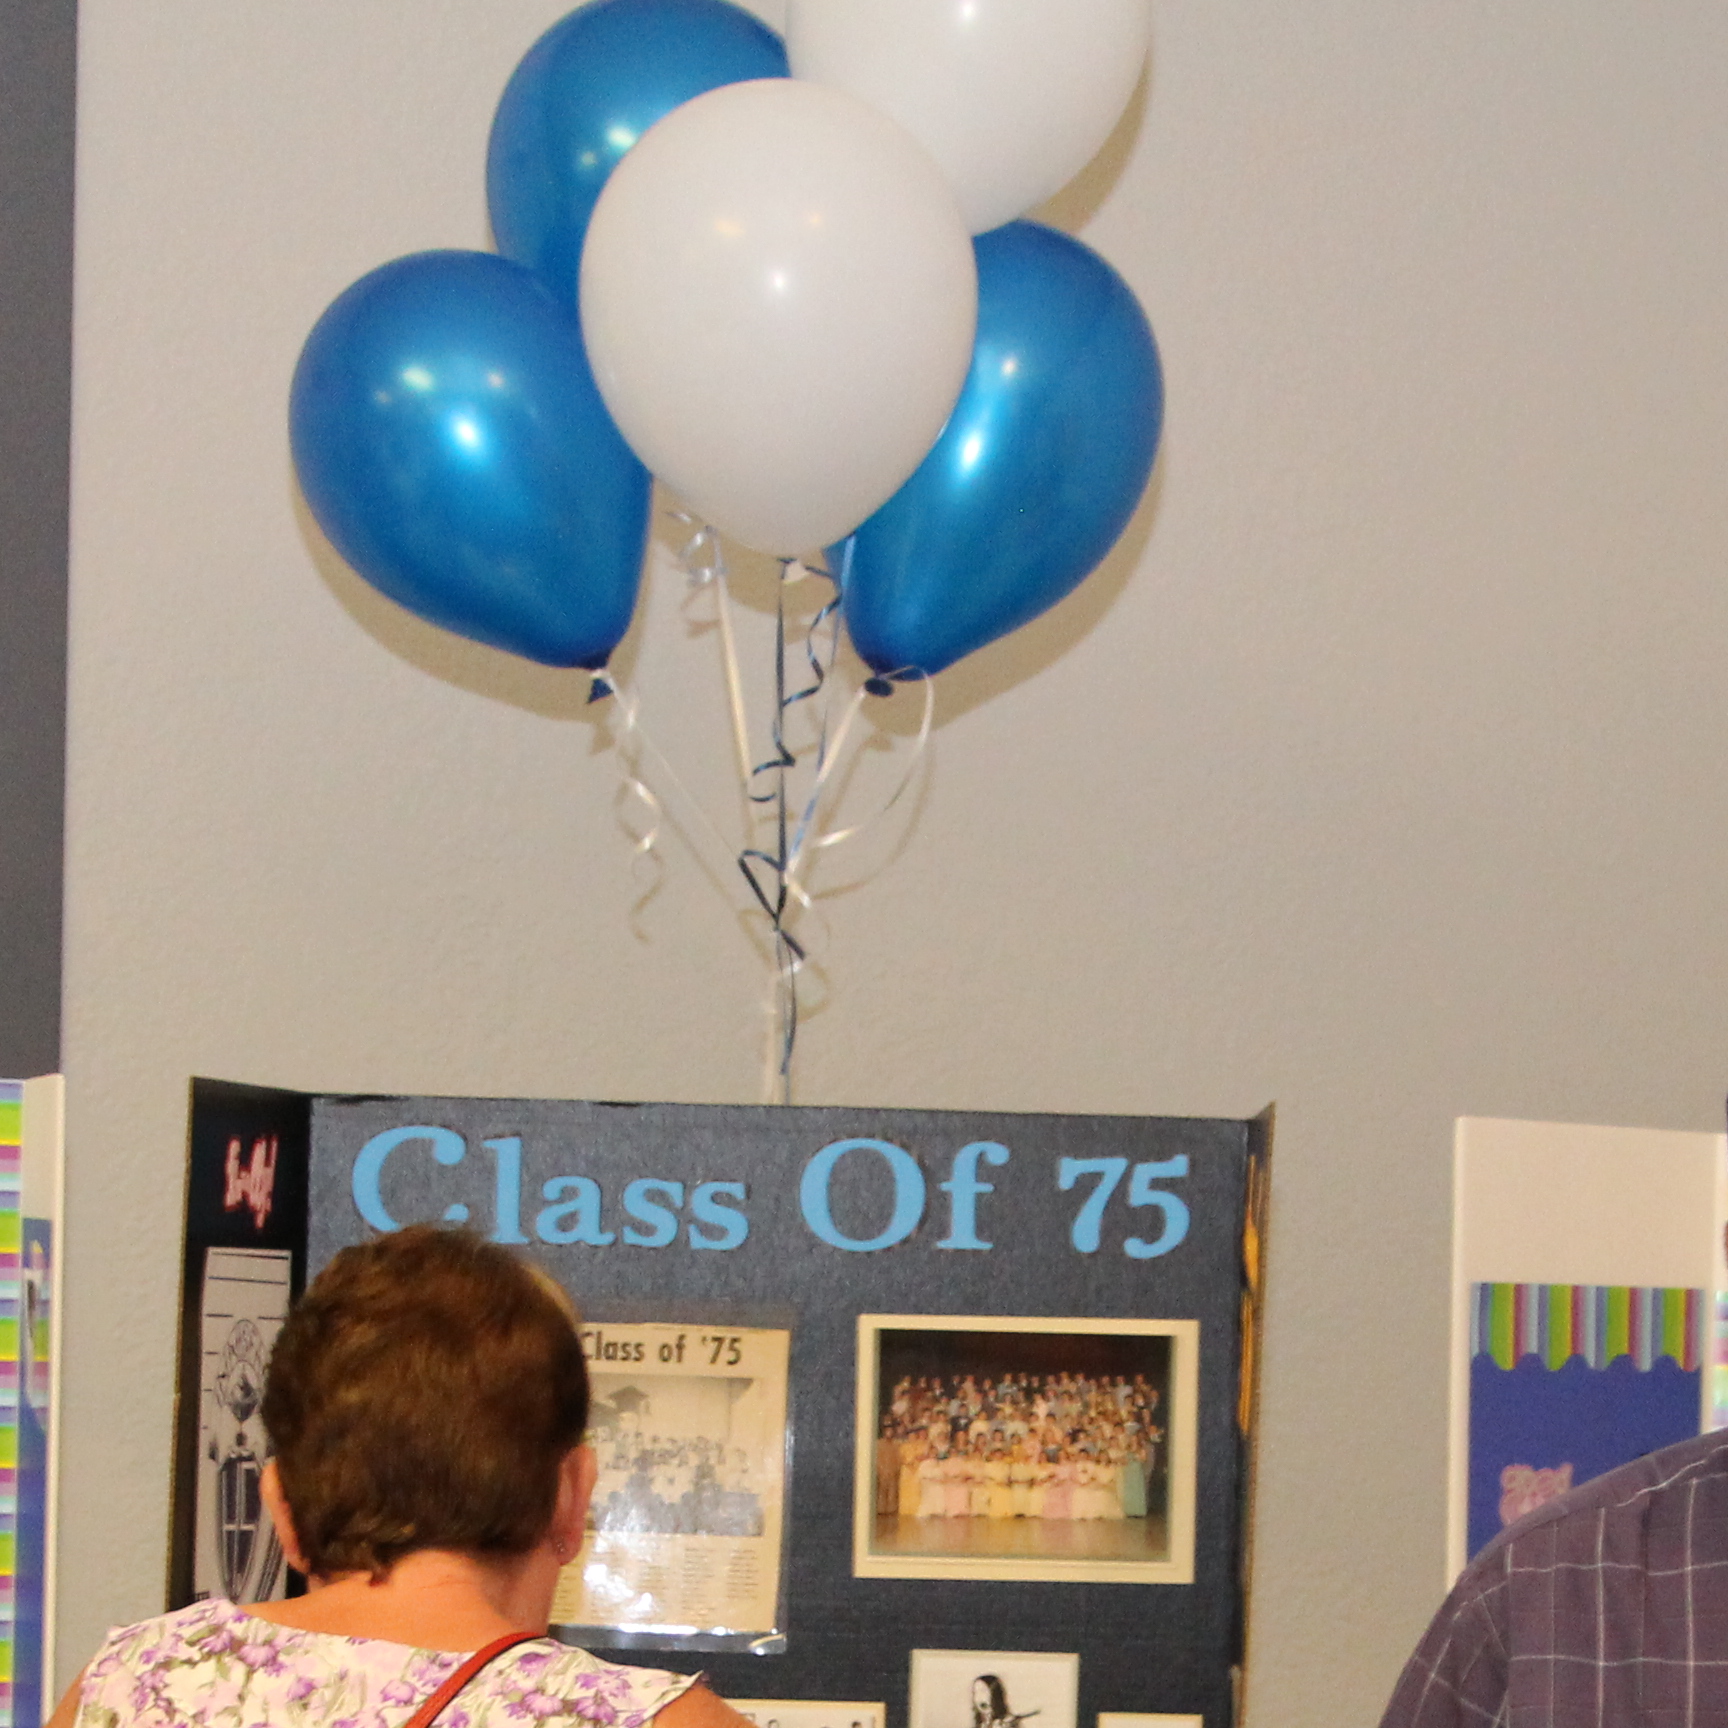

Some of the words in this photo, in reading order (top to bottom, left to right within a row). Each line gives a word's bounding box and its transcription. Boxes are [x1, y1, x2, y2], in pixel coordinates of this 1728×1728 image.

[351, 1125, 750, 1252] Class
[800, 1138, 1010, 1253] Of
[1058, 1155, 1191, 1260] 75
[582, 1330, 645, 1363] Class
[659, 1333, 685, 1364] of
